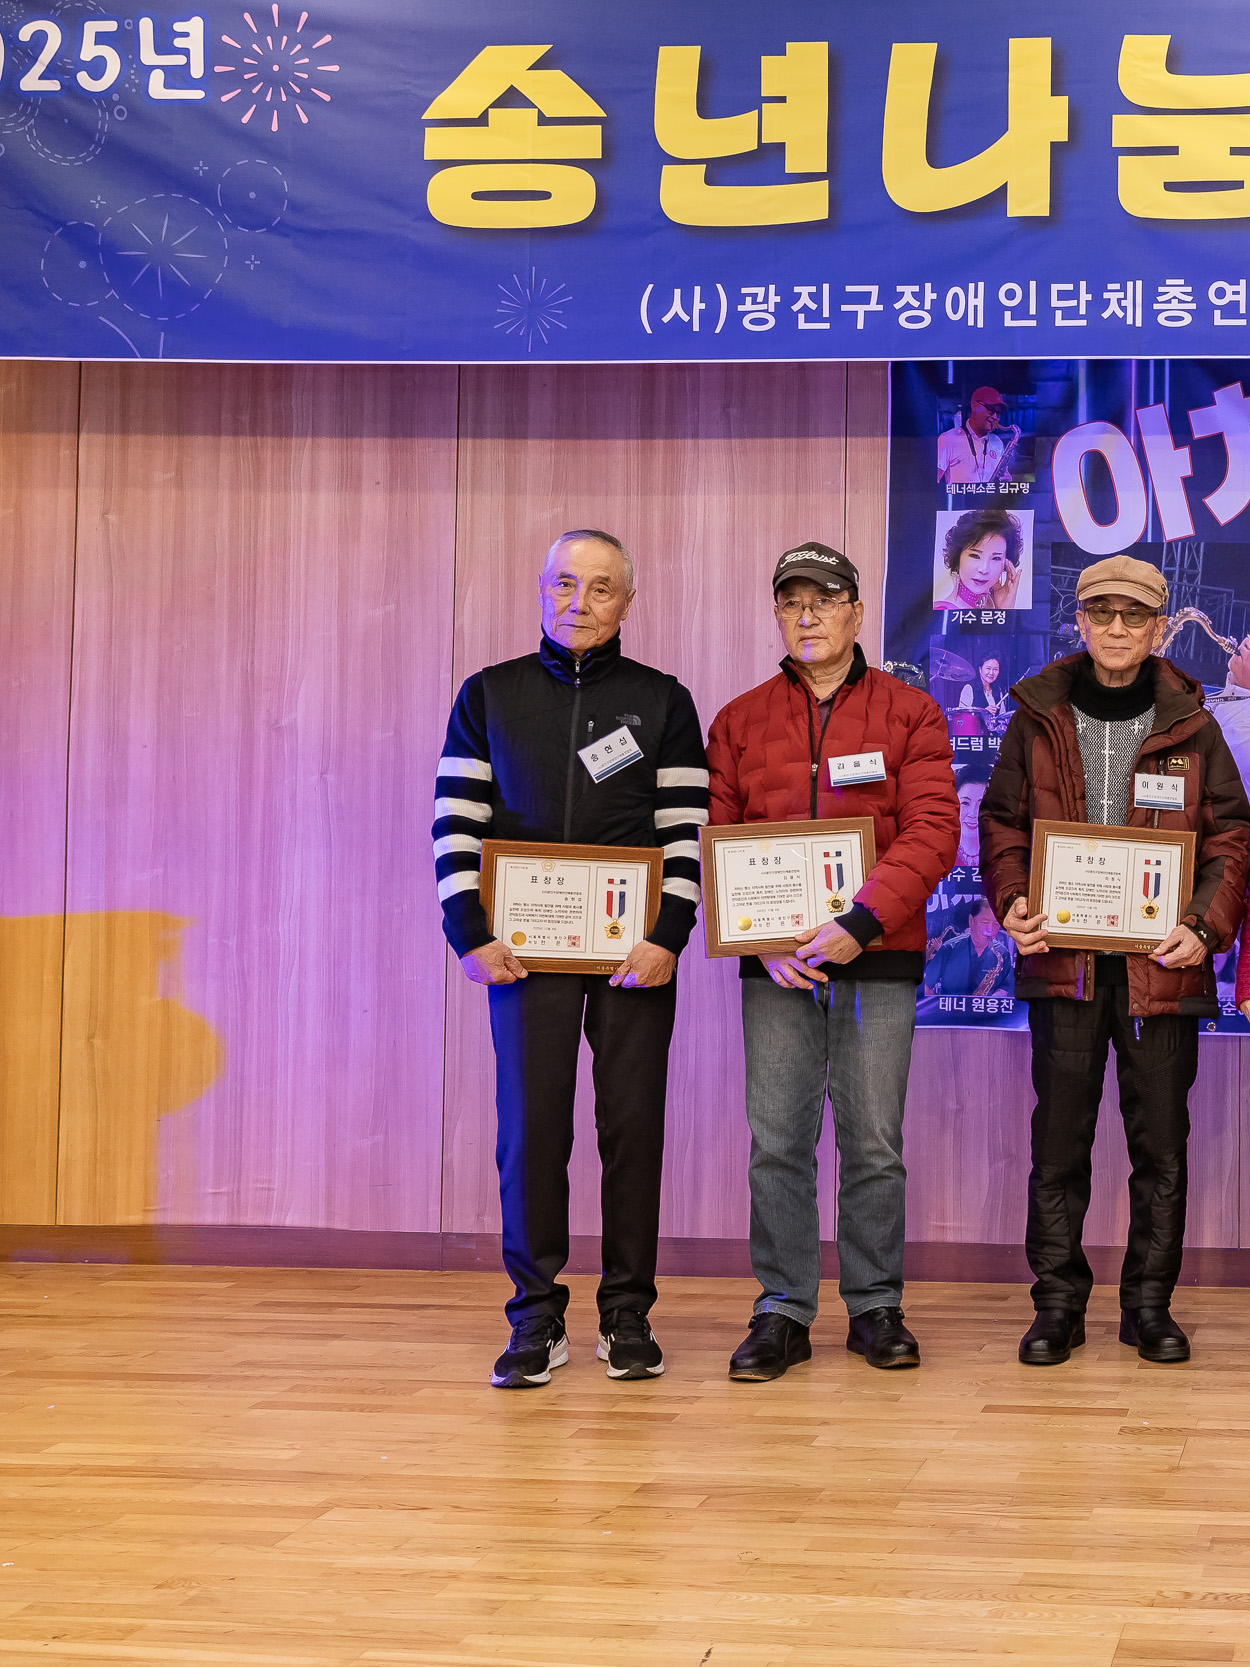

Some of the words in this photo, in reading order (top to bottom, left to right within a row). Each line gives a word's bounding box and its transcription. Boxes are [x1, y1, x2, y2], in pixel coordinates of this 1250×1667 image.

[0, 16, 206, 101] 25년
[946, 483, 996, 495] 테너색소폰
[999, 482, 1030, 494] 김규명
[951, 610, 978, 625] 가수
[980, 609, 1007, 625] 문정
[939, 997, 966, 1011] 테너
[971, 997, 1014, 1013] 원용찬
